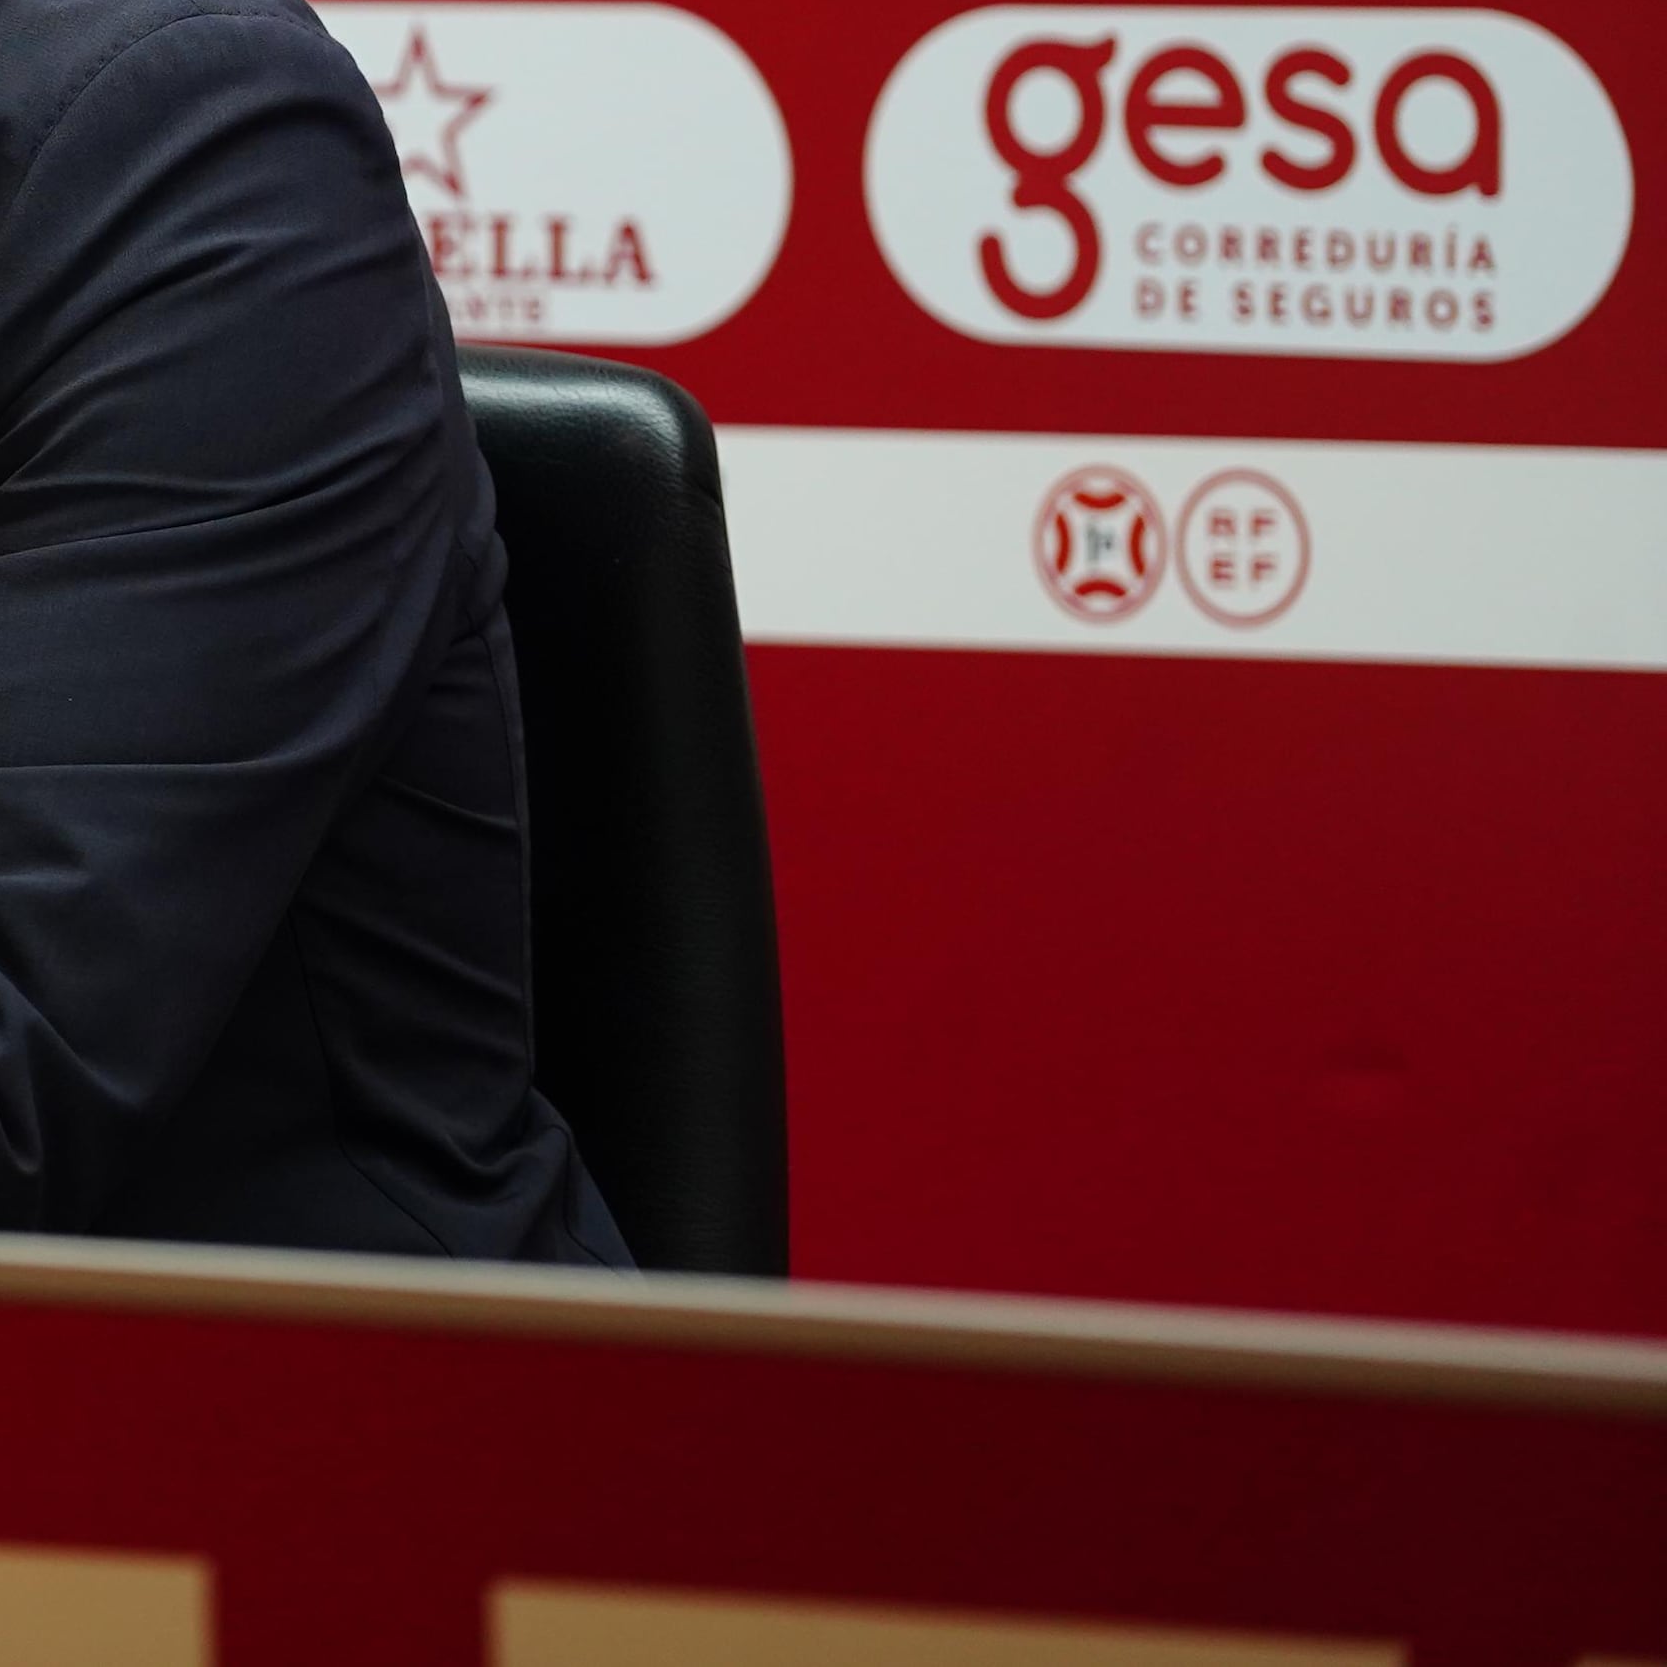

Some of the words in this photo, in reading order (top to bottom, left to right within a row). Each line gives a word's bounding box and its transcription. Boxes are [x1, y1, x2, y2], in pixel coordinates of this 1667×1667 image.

[978, 31, 1505, 324] gesa
[1133, 222, 1499, 276] CORREDURÍA
[1134, 277, 1199, 322] DE
[1231, 281, 1499, 333] SEGUROS
